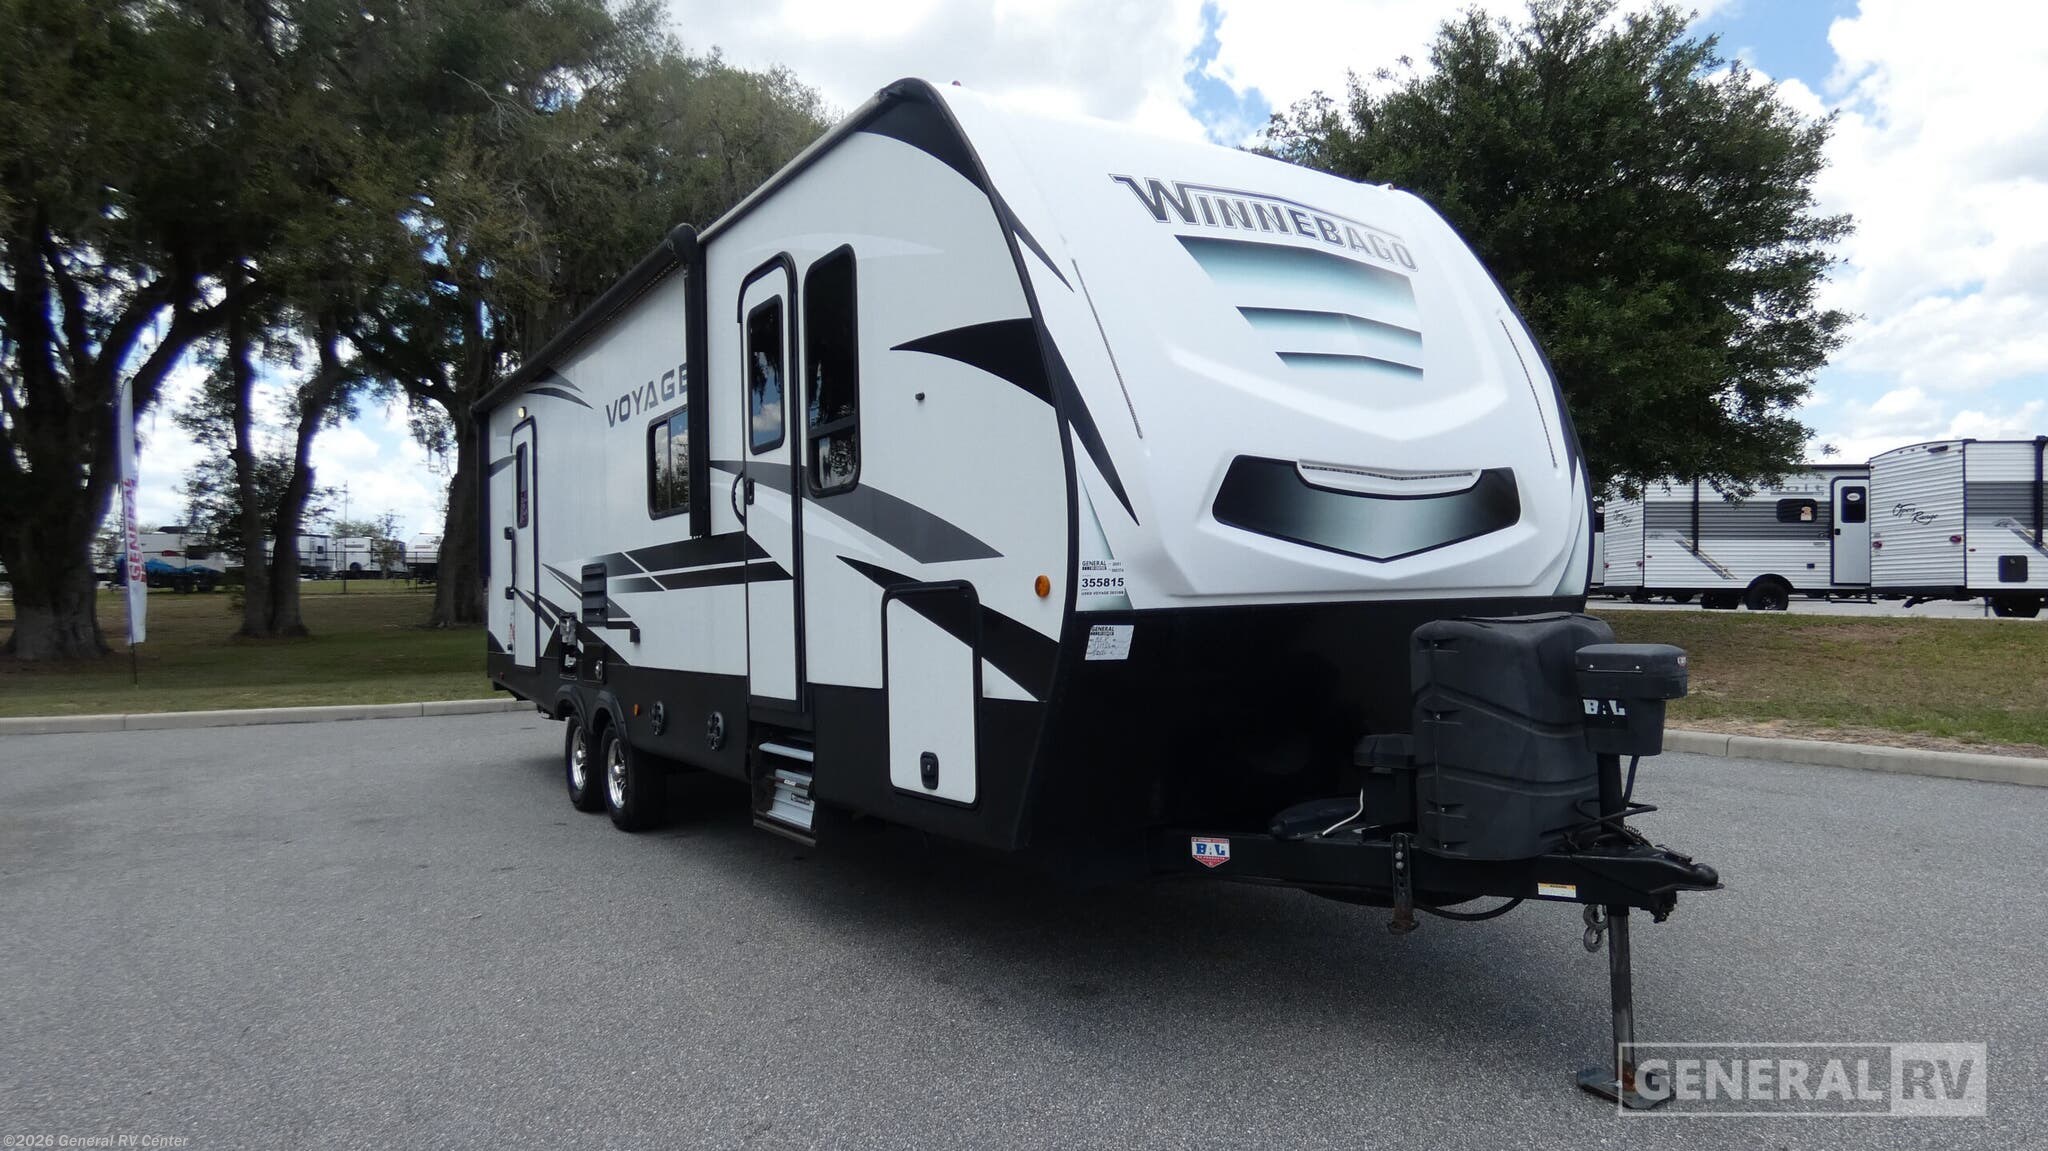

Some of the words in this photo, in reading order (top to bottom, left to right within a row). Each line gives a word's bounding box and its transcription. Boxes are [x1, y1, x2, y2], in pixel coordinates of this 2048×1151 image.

[1108, 173, 1418, 272] WINNEBAGO
[605, 361, 687, 428] VOYAGE
[1892, 503, 1916, 517] Open
[1912, 511, 1938, 525] Range
[1082, 577, 1124, 588] 355815
